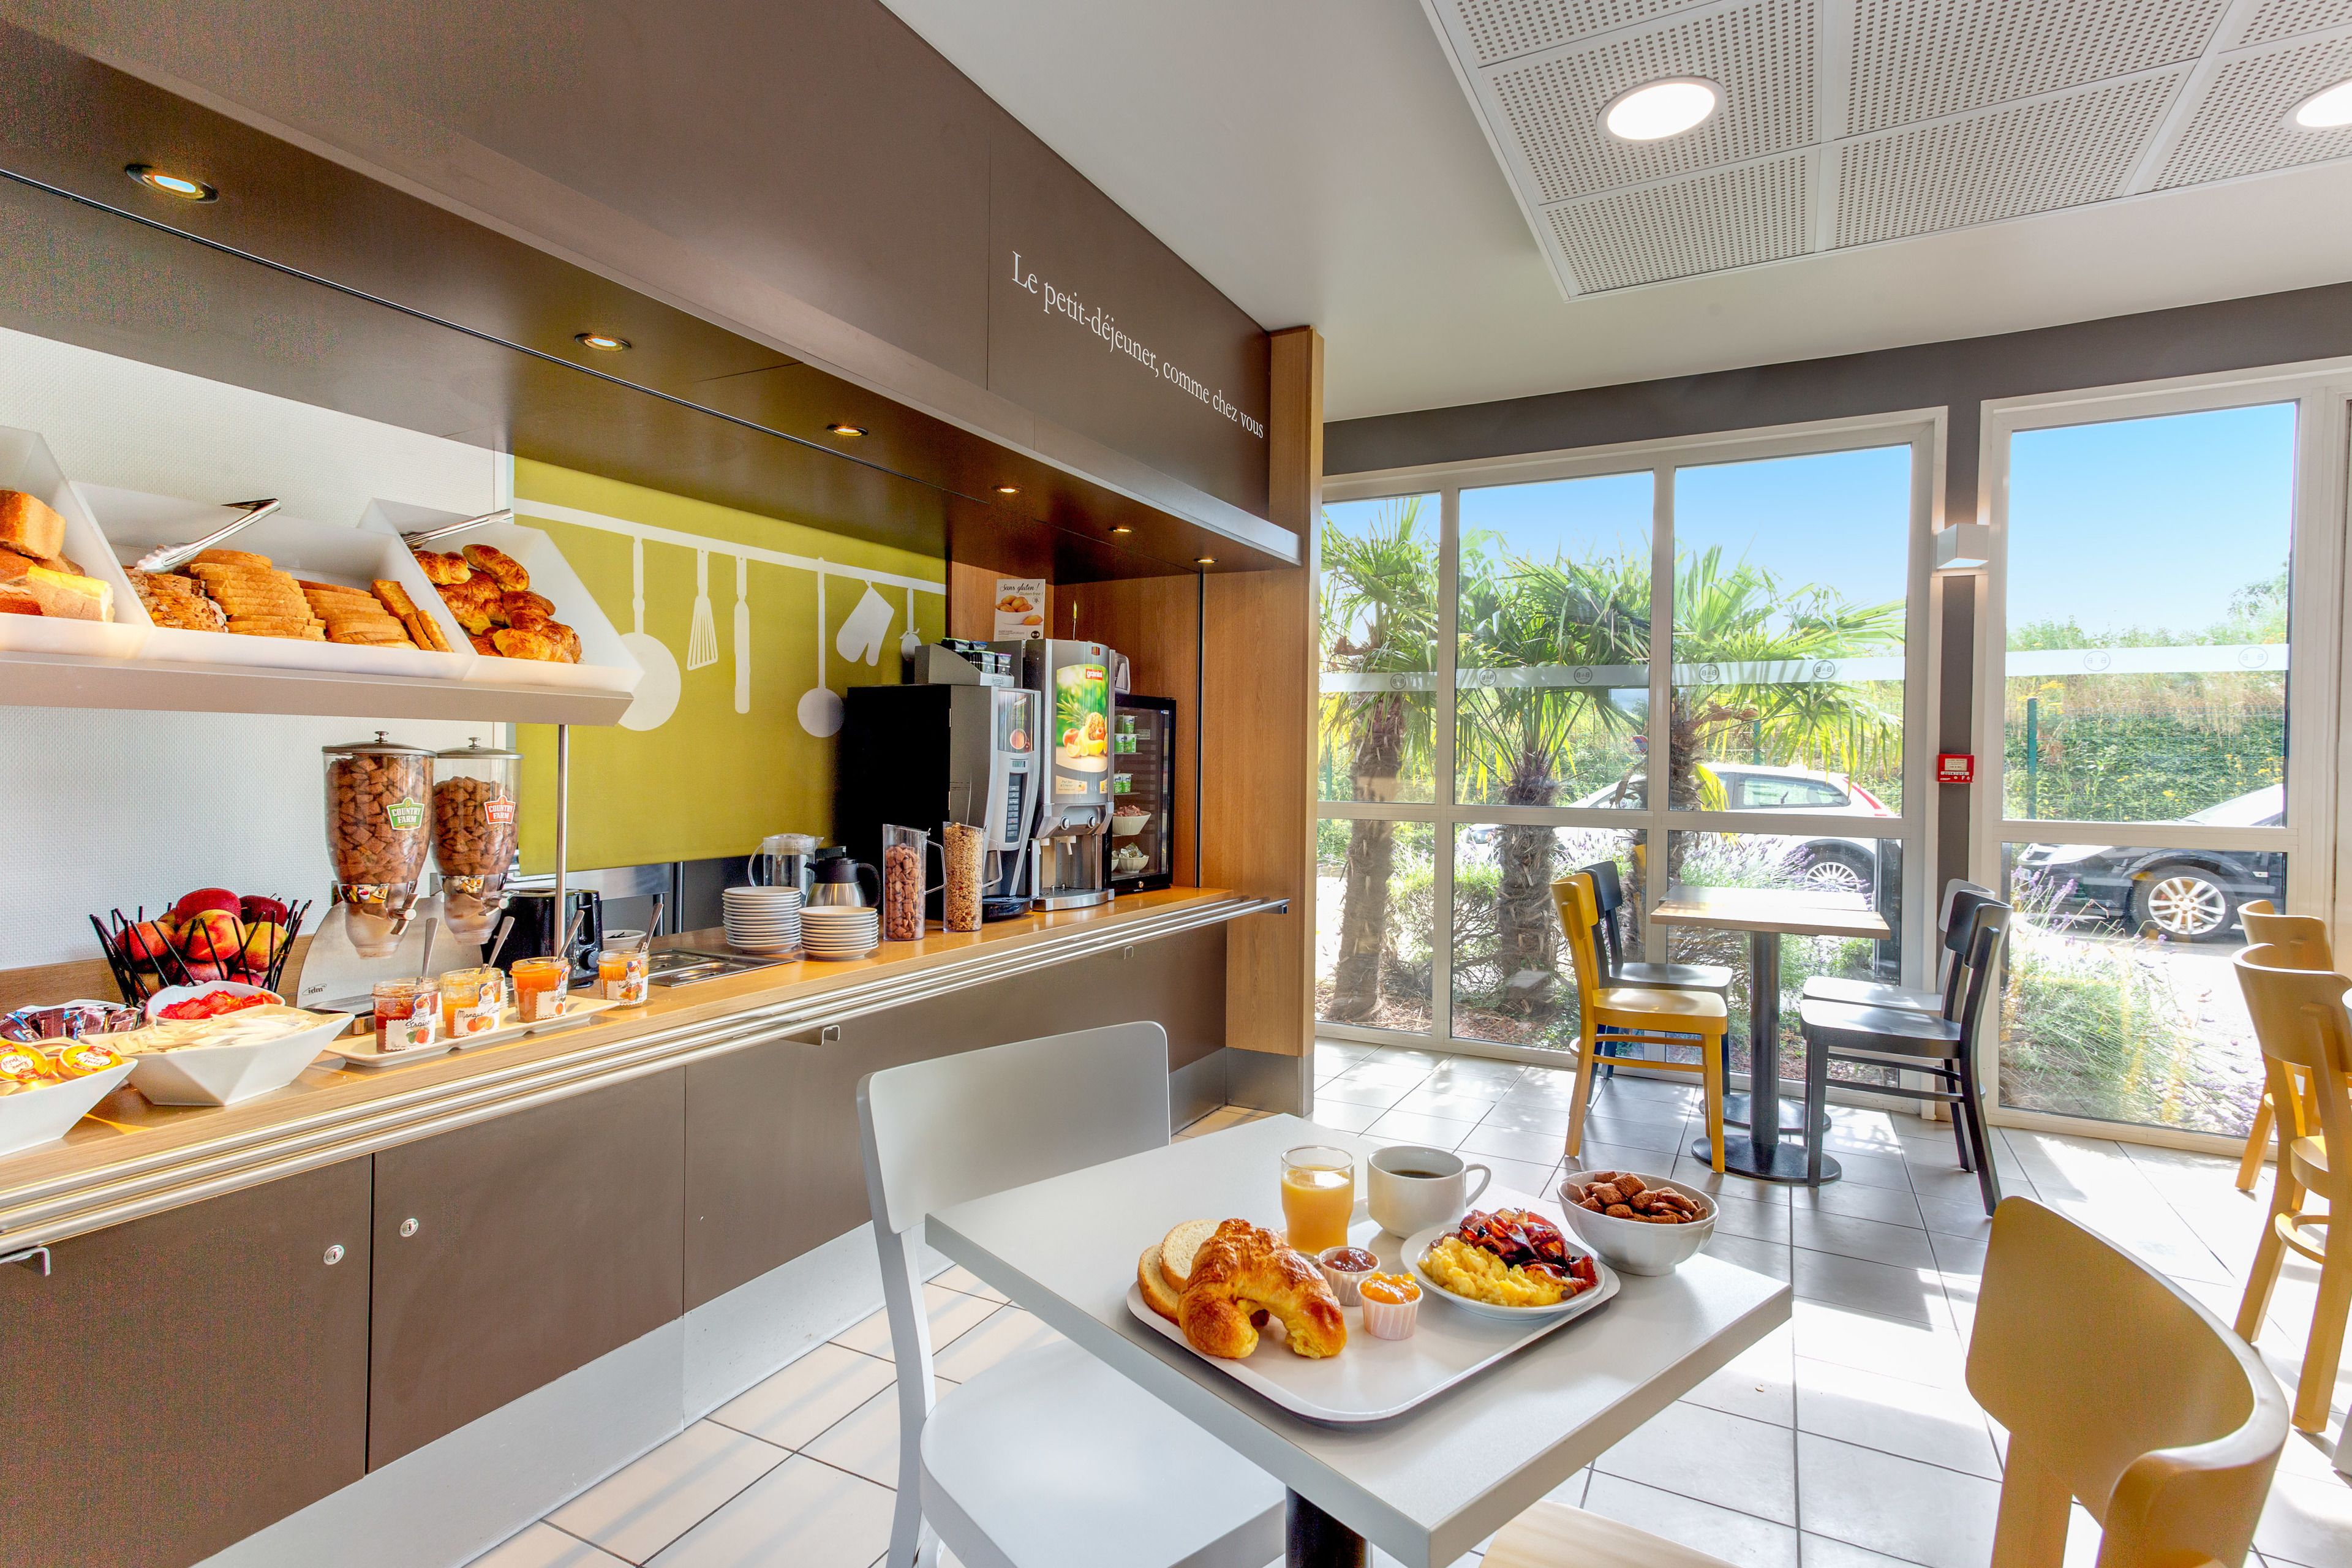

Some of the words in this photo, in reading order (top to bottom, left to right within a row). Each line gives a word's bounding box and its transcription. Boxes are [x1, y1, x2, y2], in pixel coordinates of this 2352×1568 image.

[1011, 250, 1038, 294] Le
[1044, 282, 1159, 378] petit-déjeuner,
[1163, 362, 1210, 404] comme
[1212, 390, 1238, 422] chez
[1240, 411, 1264, 439] vous
[1000, 583, 1016, 592] Sans
[1016, 582, 1035, 594] gluten
[391, 807, 421, 817] COUNTRY
[488, 805, 513, 813] COUNTRY
[398, 815, 417, 824] FARM
